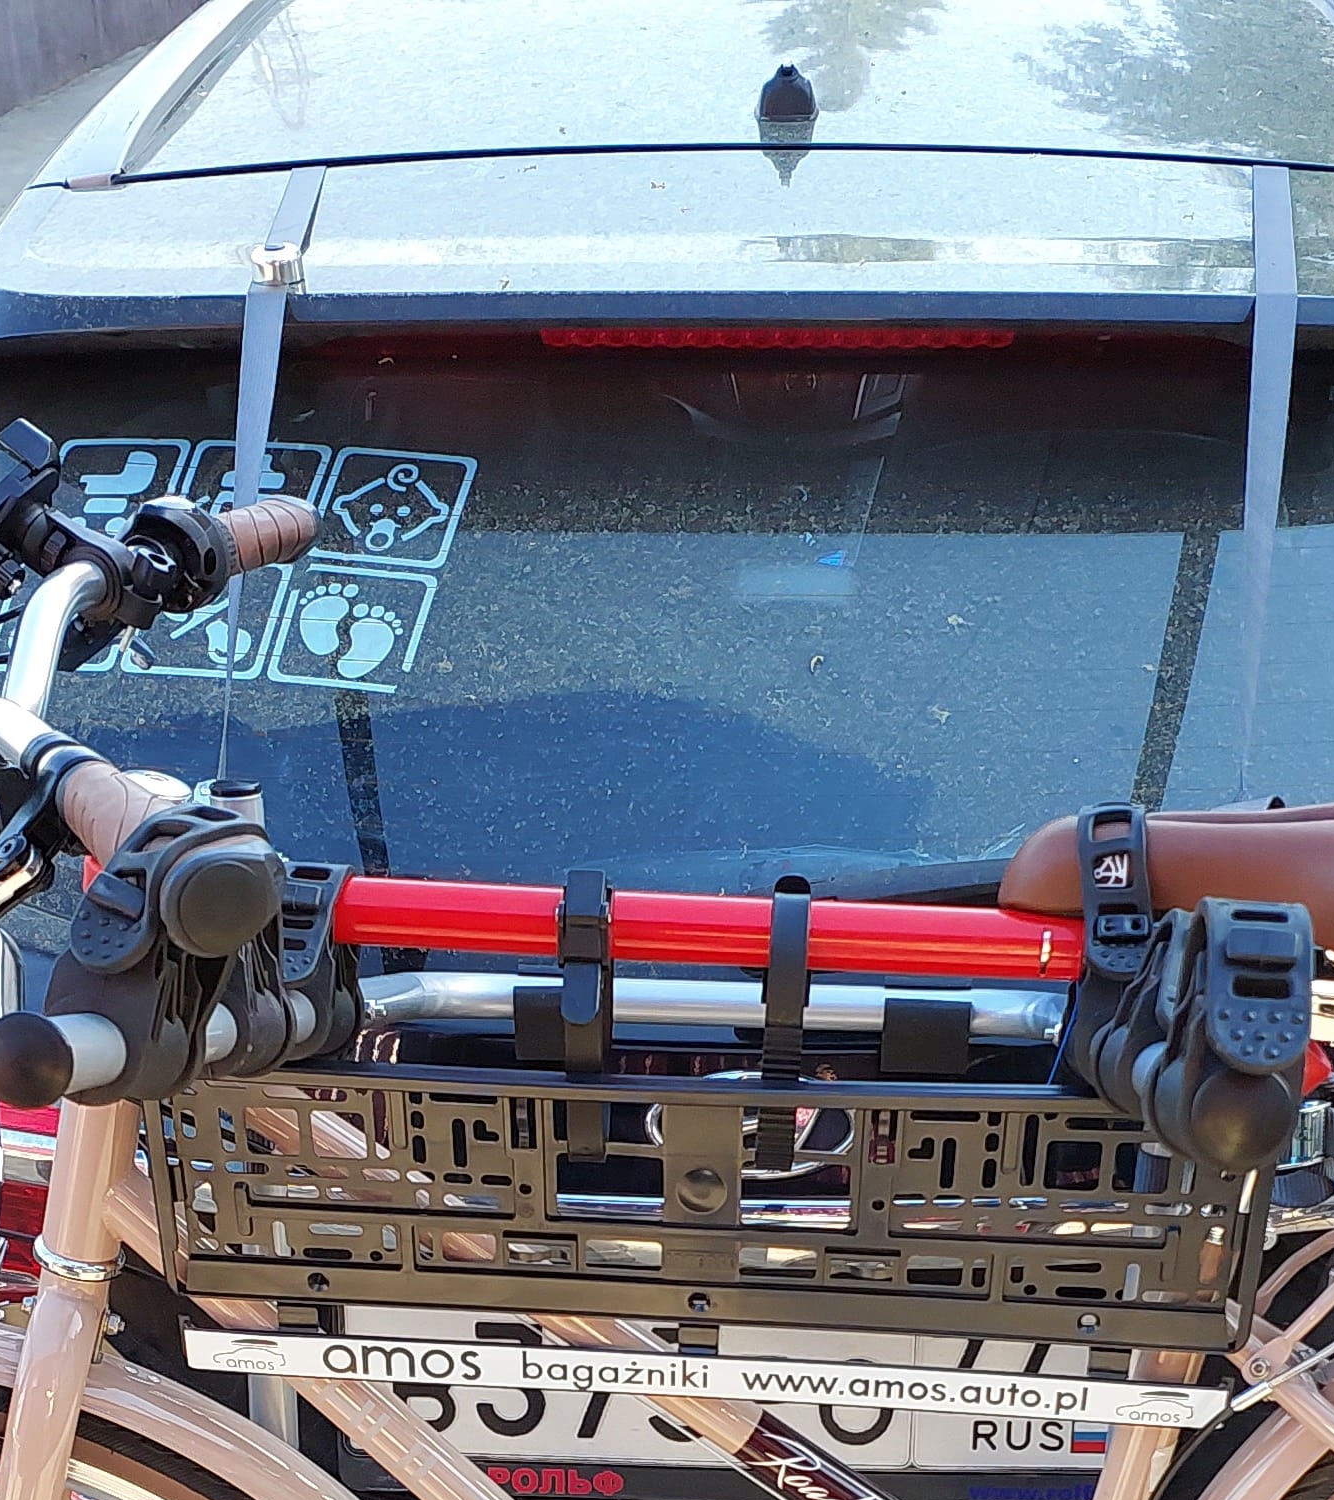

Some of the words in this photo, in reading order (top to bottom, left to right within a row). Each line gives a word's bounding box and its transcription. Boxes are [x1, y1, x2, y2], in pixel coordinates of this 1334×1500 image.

[226, 1357, 275, 1371] amos
[322, 1344, 482, 1381] amos
[521, 1350, 709, 1390] bagażniki
[740, 1369, 1089, 1415] www.amos.auto.pl
[1128, 1410, 1181, 1423] amos
[971, 1420, 1065, 1451] RUS
[486, 1466, 624, 1497] РОЛЬФ
